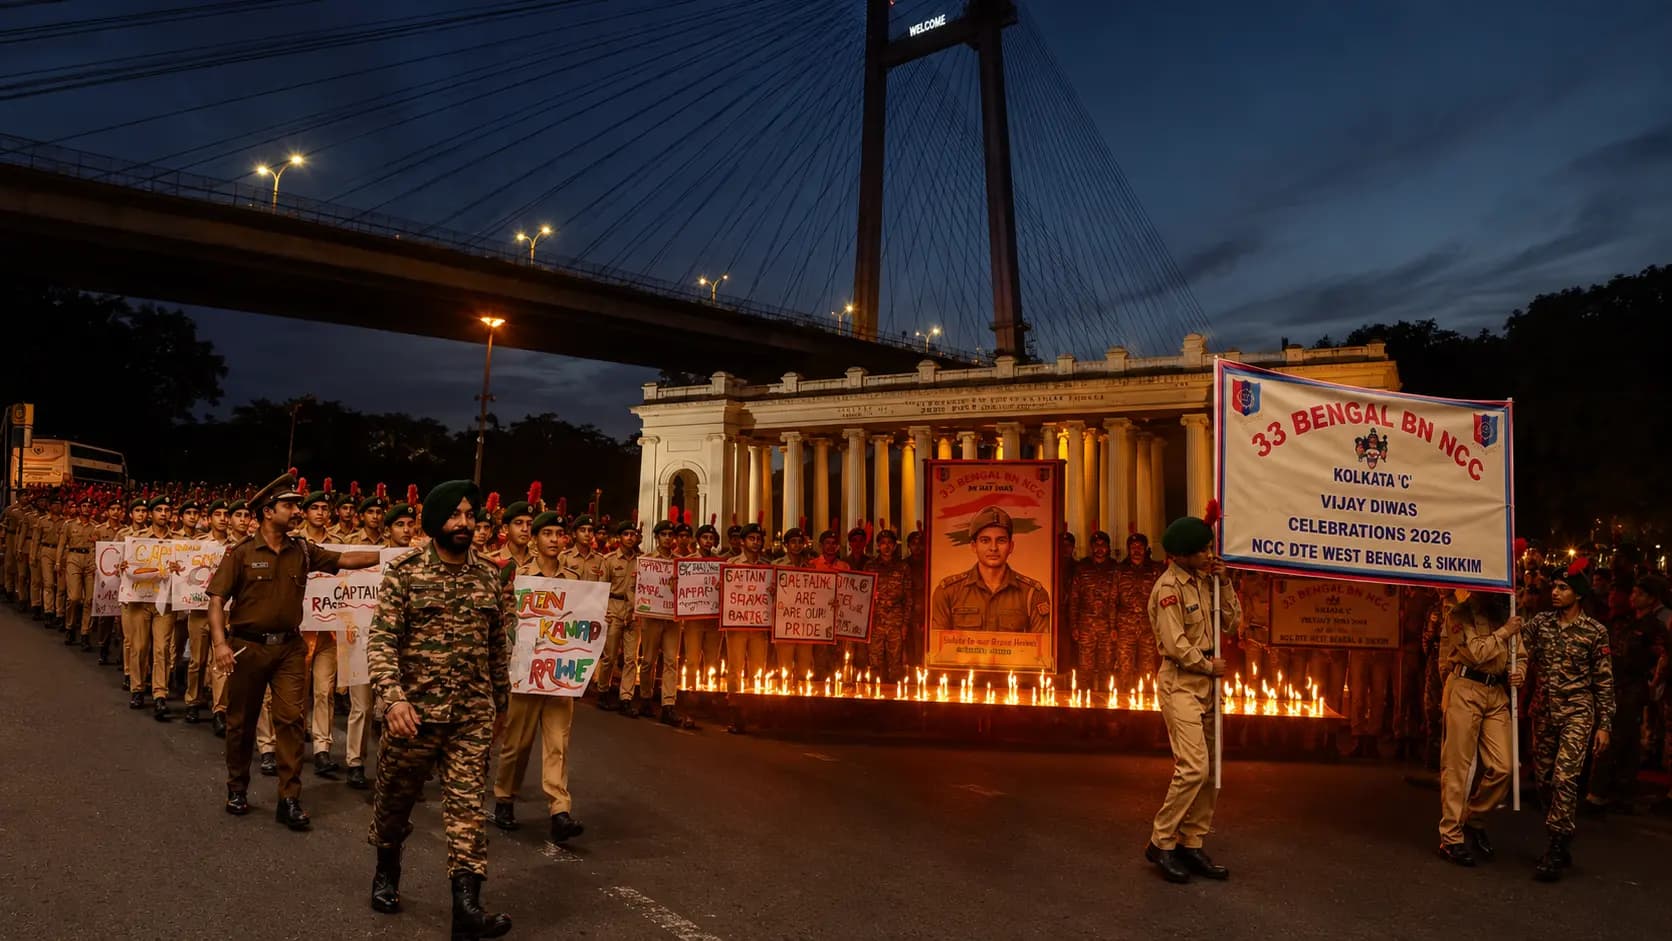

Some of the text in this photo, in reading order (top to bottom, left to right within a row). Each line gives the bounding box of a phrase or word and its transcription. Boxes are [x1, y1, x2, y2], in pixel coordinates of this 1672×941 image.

[909, 14, 946, 37] WELCOME
[1251, 401, 1485, 481] 33 BENGAL BN NCC
[957, 471, 1001, 486] BENGAL
[1333, 468, 1413, 489] KOLKATA 'C'
[1321, 494, 1418, 517] VIJAY DIWAS
[1288, 517, 1451, 545] CELEBRATIONS 2026
[1252, 538, 1482, 573] NCC DTE WEST BENGAL & SIKKIM
[795, 592, 816, 605] ARE
[1297, 583, 1344, 600] BENGAL
[783, 607, 801, 618] ARE
[785, 622, 820, 636] PRIDE
